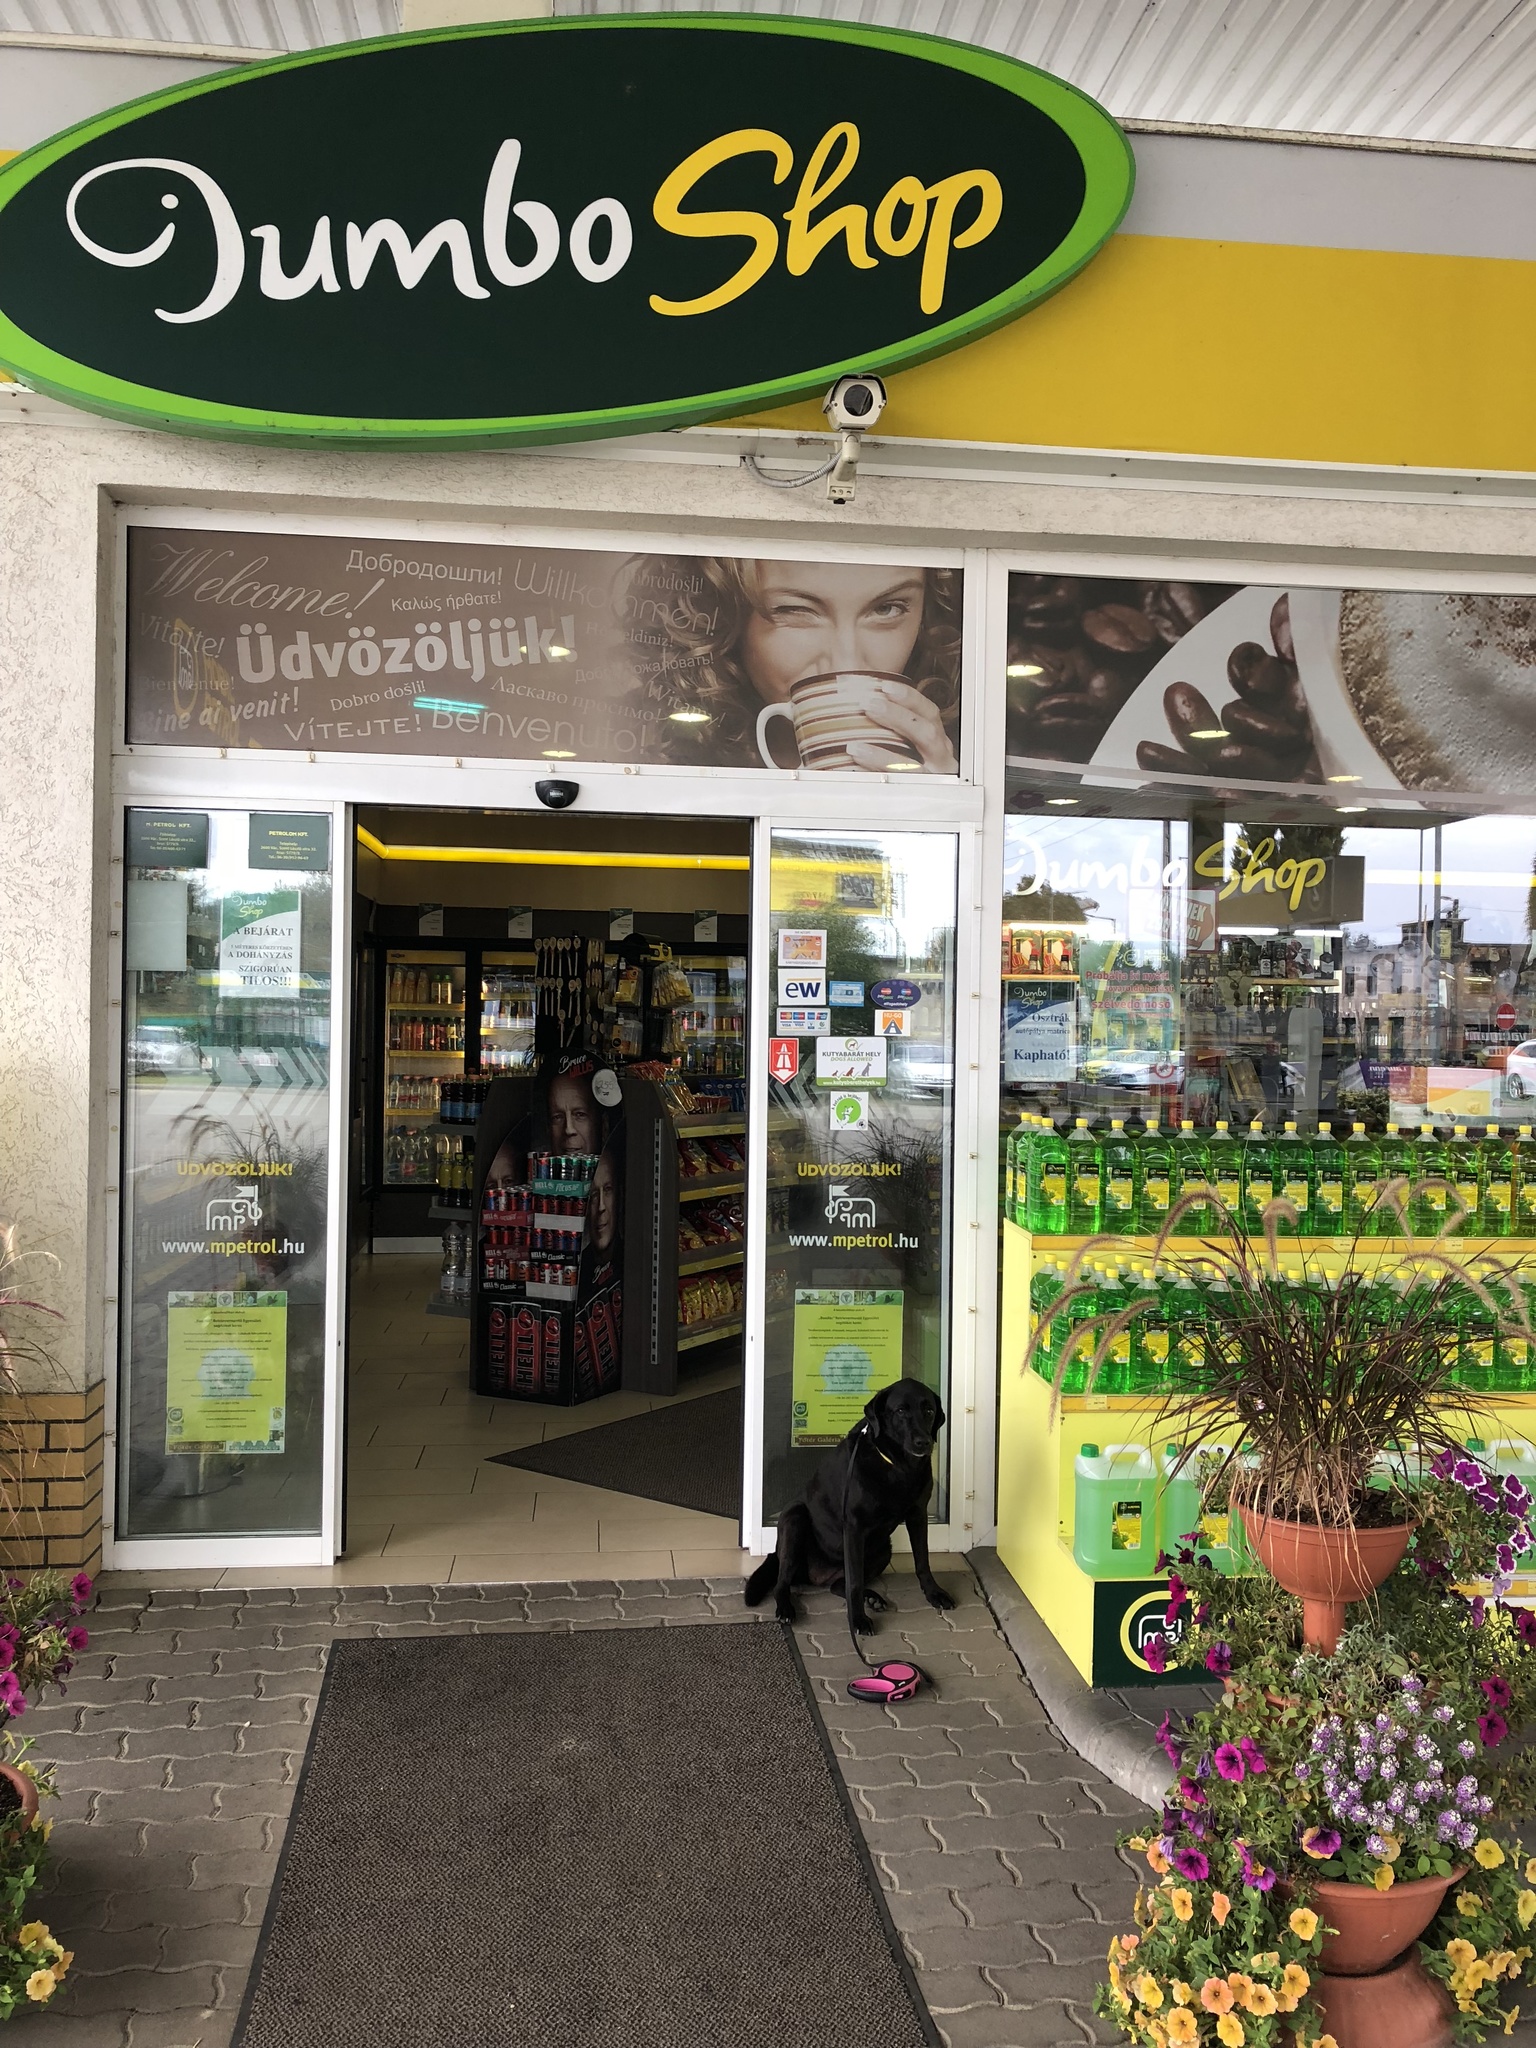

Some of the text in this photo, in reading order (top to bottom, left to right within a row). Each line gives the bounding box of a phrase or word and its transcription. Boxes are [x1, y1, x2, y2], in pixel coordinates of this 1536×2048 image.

[65, 121, 1003, 325] Jumbo Shop
[345, 548, 503, 587] Добродошли!
[146, 543, 387, 620] Welcome!
[236, 614, 579, 684] Üdvözöljük!
[229, 686, 300, 722] venit!
[330, 679, 426, 712] Dobro došli!
[1194, 837, 1326, 911] Shop
[231, 895, 267, 906] Jumbo
[244, 925, 293, 936] BEJÁRAT
[236, 950, 293, 959] DOHÁNYZÁS
[239, 964, 292, 973] SZIGORÚAN
[241, 975, 292, 986] TILOS!!!
[785, 982, 821, 998] ew
[1014, 987, 1047, 998] Jumbo
[1021, 997, 1043, 1009] Shop
[1032, 1013, 1070, 1023] Osztrák
[1013, 1048, 1070, 1063] Kapható!
[162, 1238, 306, 1257] www.mpetrol.hu
[789, 1233, 919, 1251] www.mpetrol.hu
[516, 1333, 535, 1389] HELL
[545, 1340, 561, 1389] HELL
